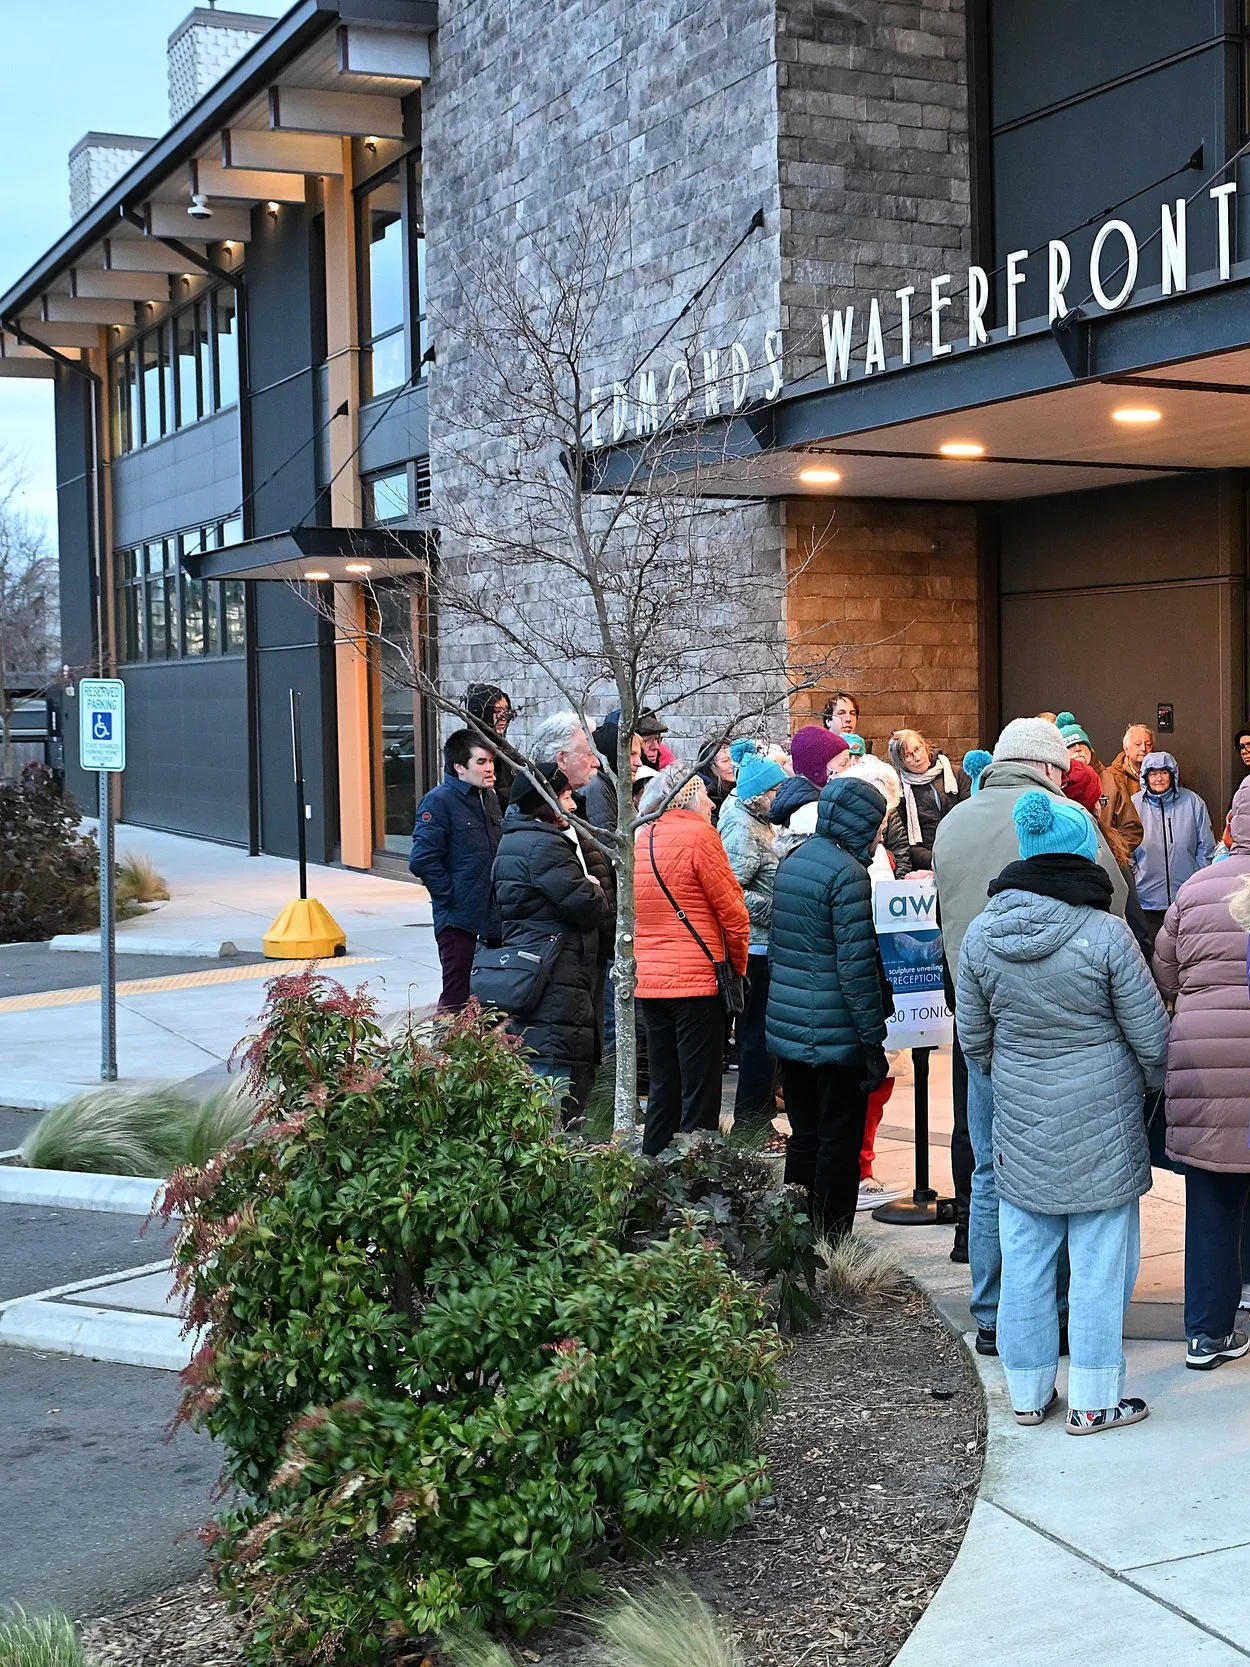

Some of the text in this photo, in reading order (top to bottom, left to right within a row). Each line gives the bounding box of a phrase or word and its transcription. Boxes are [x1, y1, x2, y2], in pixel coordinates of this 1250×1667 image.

[591, 330, 783, 446] EDMONDS
[822, 183, 1236, 384] WATERFRONT
[84, 686, 120, 698] RESERVED
[88, 699, 117, 710] PARKING
[889, 895, 935, 917] aw
[889, 963, 944, 976] sculpture unveiling
[894, 973, 941, 985] RECEPTION
